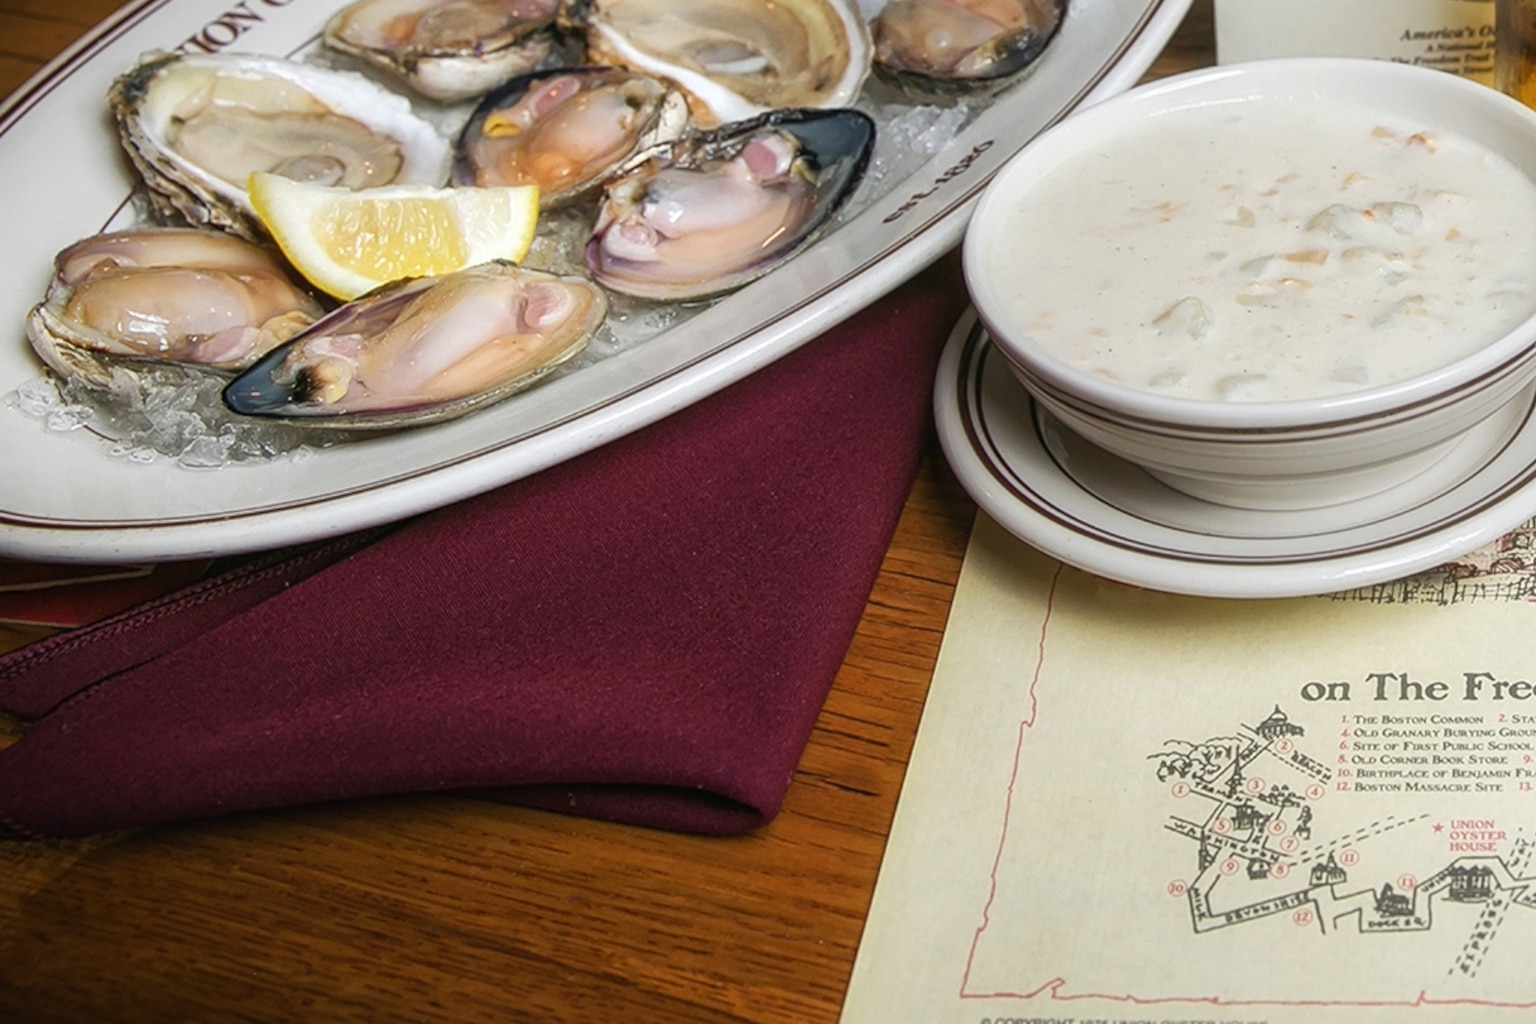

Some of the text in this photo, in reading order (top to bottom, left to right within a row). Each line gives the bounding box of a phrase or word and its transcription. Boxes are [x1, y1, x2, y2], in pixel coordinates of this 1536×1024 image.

[173, 0, 265, 60] NION
[1300, 682, 1351, 702] on
[1365, 672, 1450, 702] The
[1340, 714, 1350, 724] 1.
[1353, 714, 1378, 725] THE
[1381, 714, 1428, 725] BOSTON
[1430, 714, 1484, 725] COMMON
[1498, 713, 1508, 724] 2.
[1340, 727, 1350, 738] 4.
[1353, 727, 1379, 738] OLD
[1382, 727, 1441, 738] GRANARY
[1444, 727, 1497, 738] BURYING
[1339, 740, 1349, 751] 6.
[1352, 741, 1380, 752] SITE
[1403, 740, 1439, 752] FIRST
[1442, 740, 1485, 751] PUBLIC
[1487, 740, 1535, 751] SCHOOL
[1337, 754, 1347, 765] 8.
[1351, 754, 1377, 765] OLD
[1379, 754, 1431, 765] CORNER
[1434, 754, 1465, 765] BOOK
[1469, 754, 1509, 765] STORE
[1337, 767, 1352, 778] 10.
[1356, 768, 1428, 779] BIRTHPLACE
[1451, 768, 1511, 779] BENJAMIN
[1336, 781, 1350, 792] 12.
[1353, 781, 1402, 793] BOSTON
[1404, 781, 1472, 793] MASSACRE
[1474, 781, 1504, 792] SITE
[1449, 819, 1495, 830] UNION
[1449, 830, 1508, 841] OYSTER
[1449, 842, 1498, 853] HOUSE
